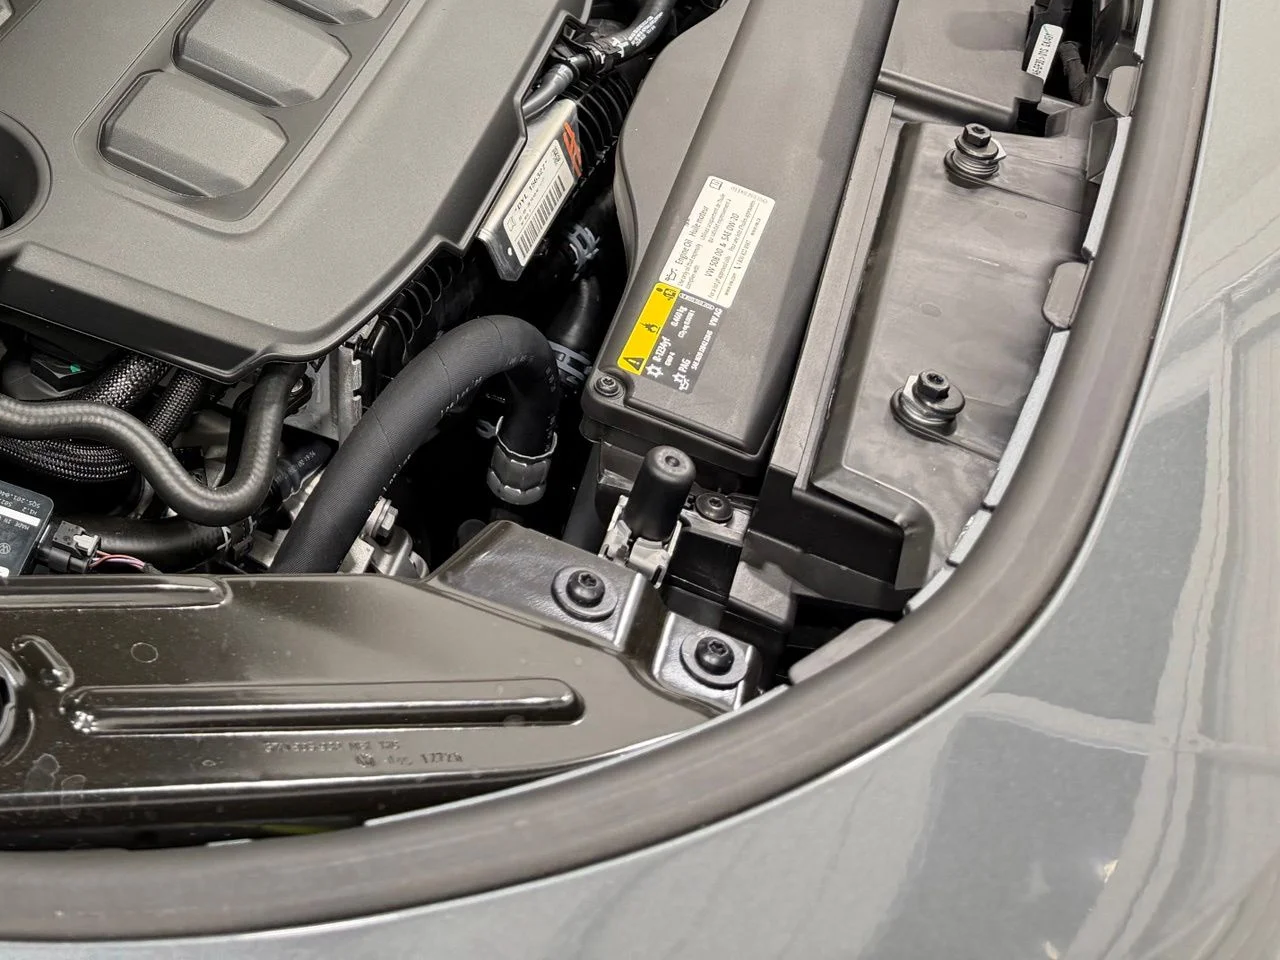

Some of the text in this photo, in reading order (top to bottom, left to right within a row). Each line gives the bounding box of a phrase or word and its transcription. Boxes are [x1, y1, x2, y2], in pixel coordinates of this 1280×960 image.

[688, 204, 709, 237] Huile moteur
[674, 238, 693, 265] Engine Oil
[703, 265, 715, 277] VW
[720, 229, 732, 241] SAE
[677, 357, 691, 373] PAG
[14, 521, 30, 530] MADE
